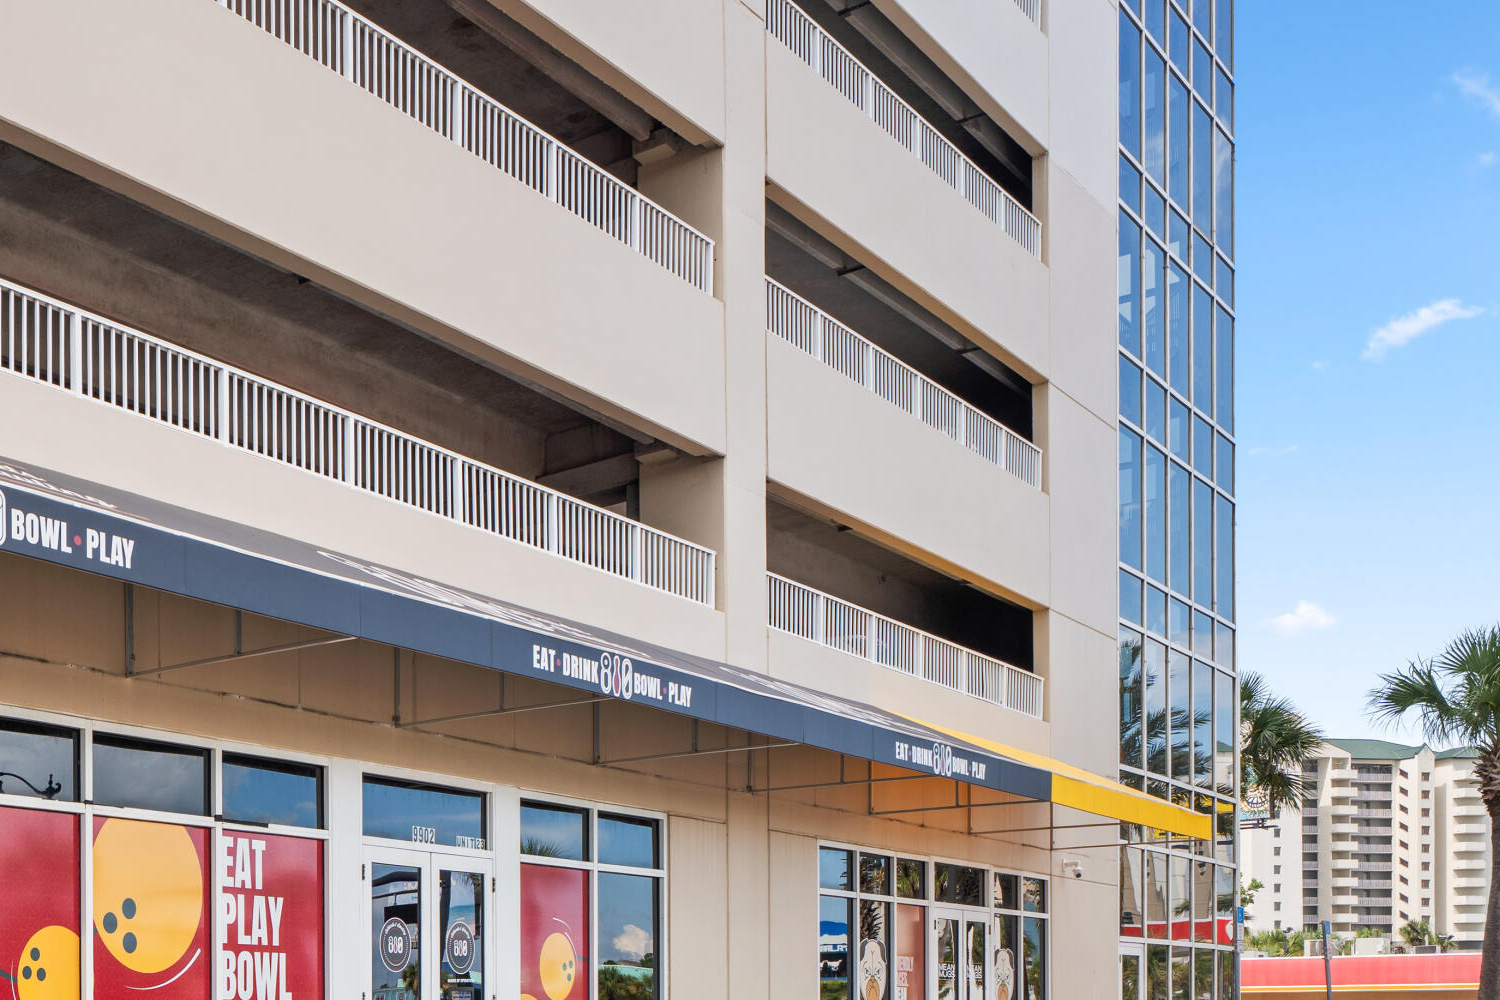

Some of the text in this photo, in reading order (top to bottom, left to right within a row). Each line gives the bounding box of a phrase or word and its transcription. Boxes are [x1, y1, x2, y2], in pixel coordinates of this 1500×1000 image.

[11, 508, 73, 554] BOWL
[86, 527, 134, 569] PLAY
[532, 644, 557, 673] EAT
[562, 652, 599, 684] DRINK
[600, 652, 633, 700] 810
[633, 672, 663, 700] BOWL
[668, 681, 692, 708] PLAY
[895, 741, 909, 761] EAT
[911, 745, 933, 767] DRINK
[952, 756, 969, 776] BOWL
[971, 761, 986, 780] PLAY
[222, 835, 266, 890] EAT
[413, 826, 435, 844] 9902
[457, 836, 474, 849] UNIT
[222, 893, 284, 947] PLAY
[222, 950, 293, 1000] BOWL
